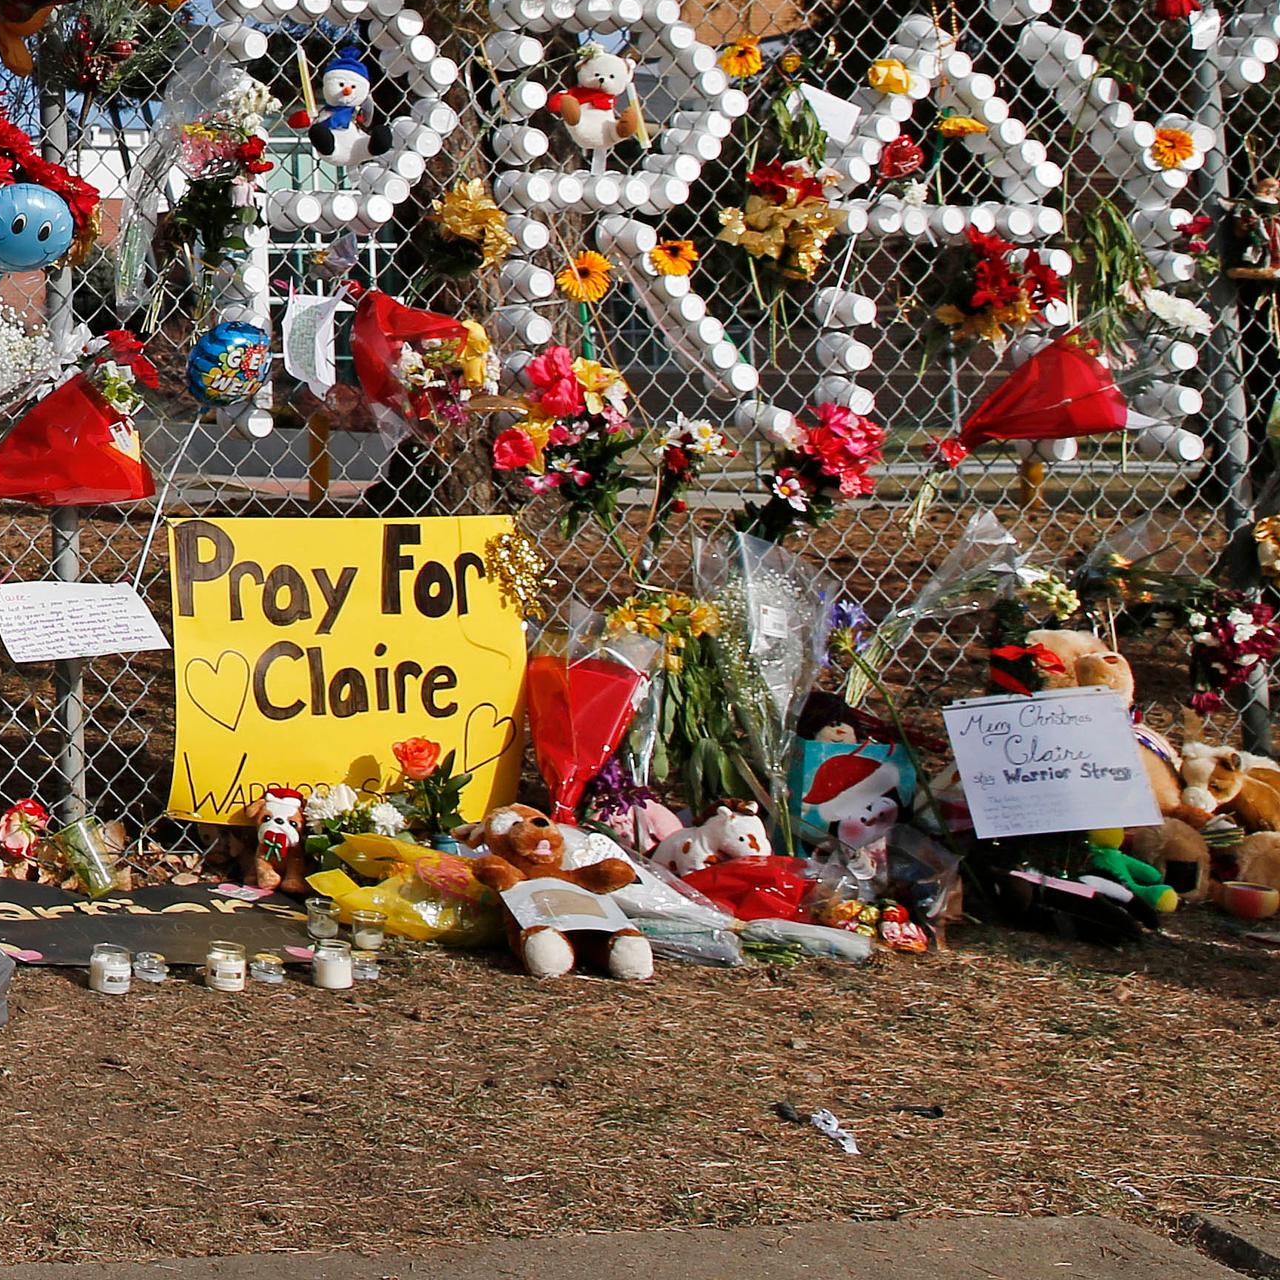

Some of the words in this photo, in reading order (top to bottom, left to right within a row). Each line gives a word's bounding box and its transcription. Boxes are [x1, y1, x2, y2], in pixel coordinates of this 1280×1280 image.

[172, 519, 358, 635] Pray
[380, 522, 486, 619] For
[253, 641, 459, 721] Claire
[1003, 733, 1093, 766] Claire
